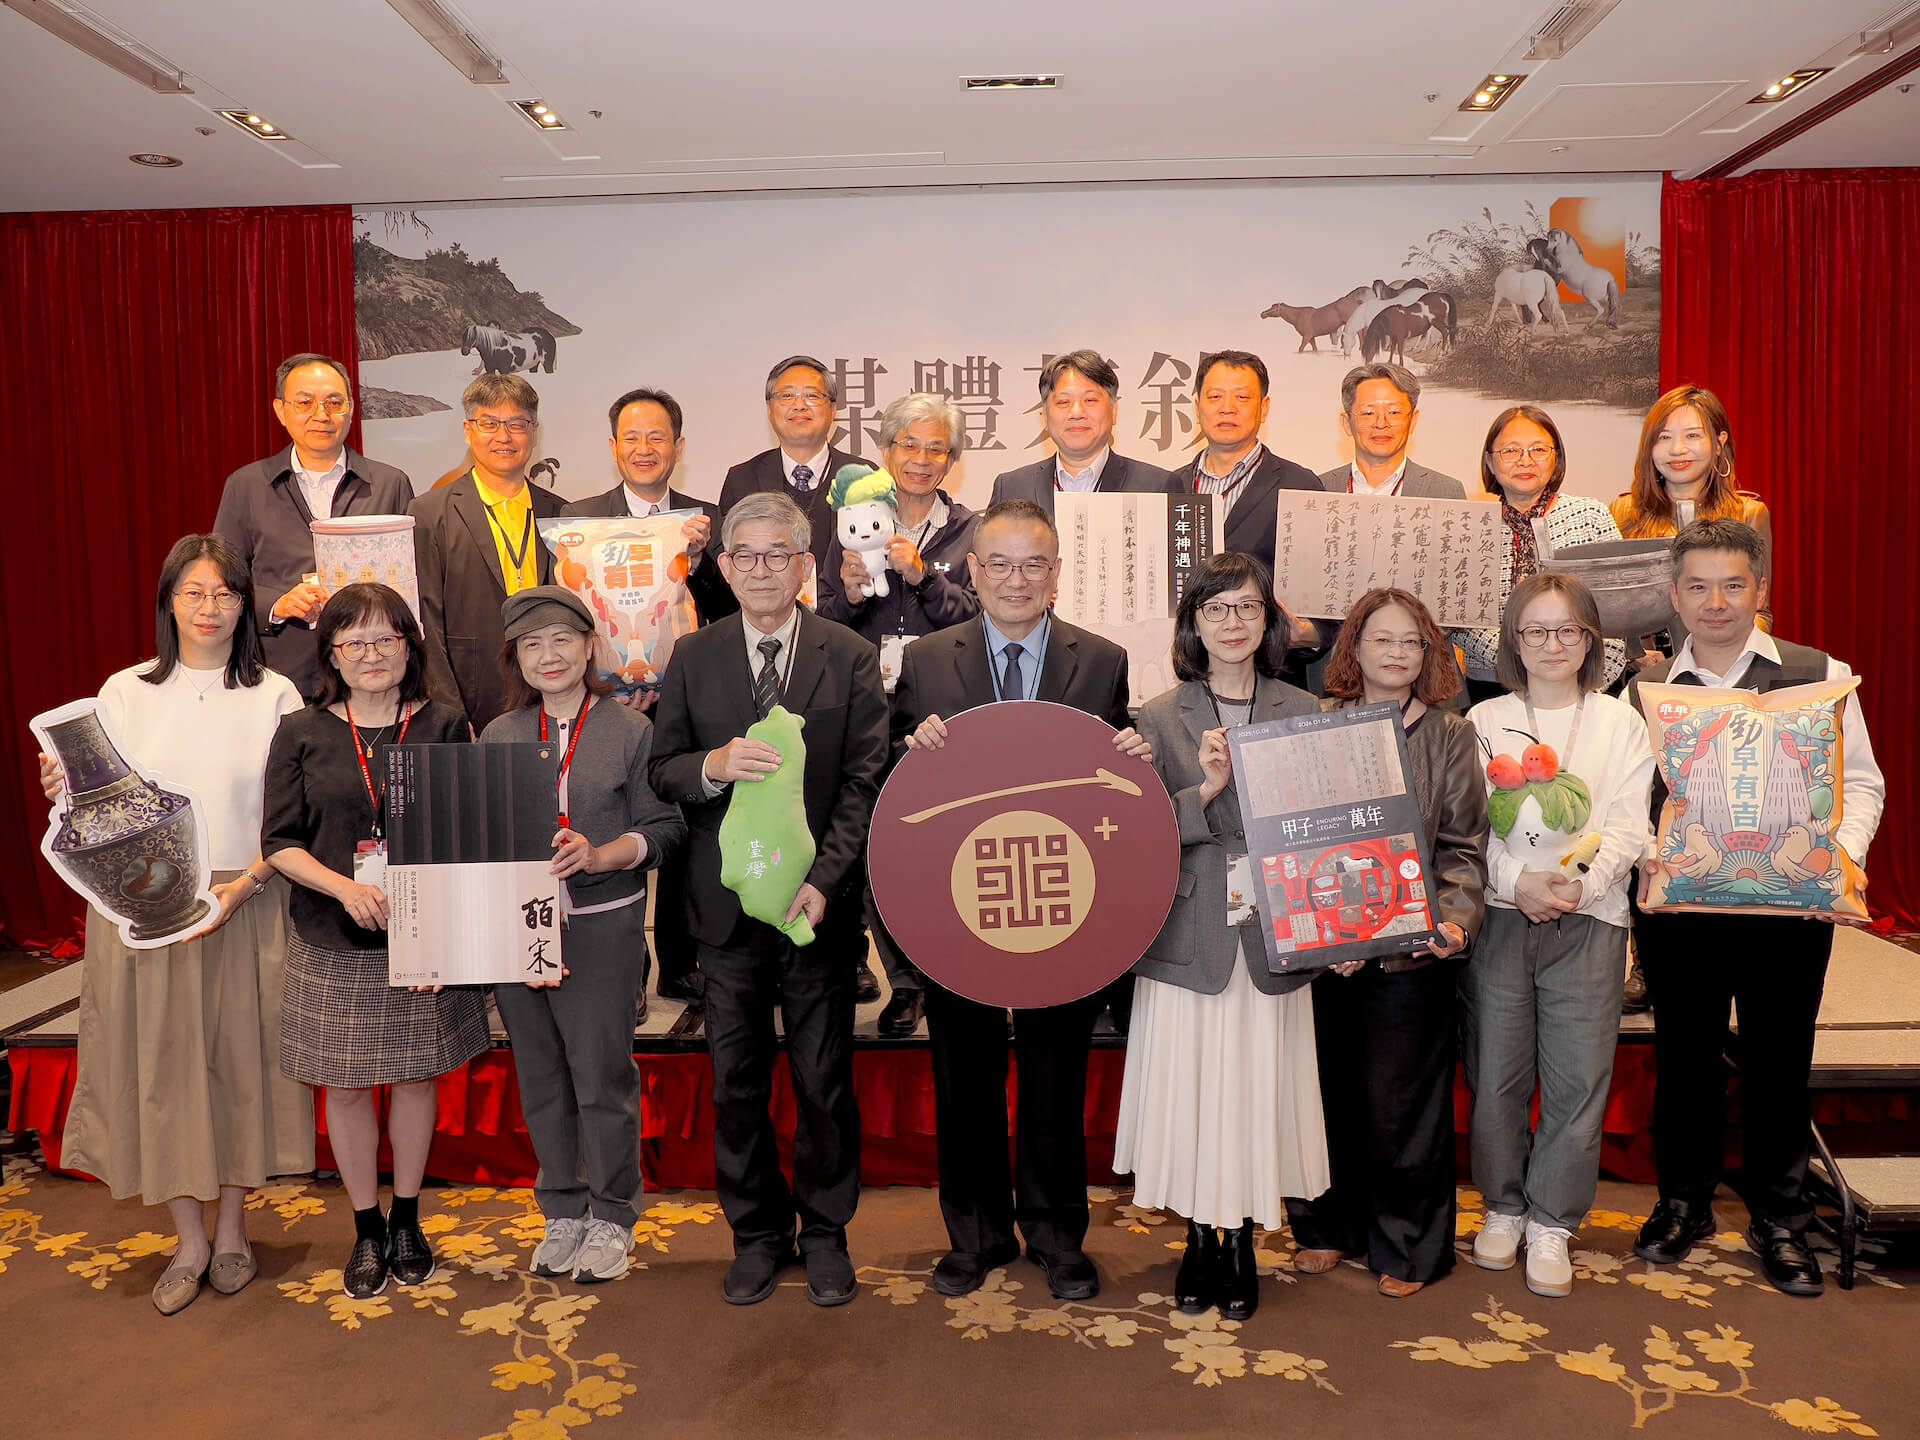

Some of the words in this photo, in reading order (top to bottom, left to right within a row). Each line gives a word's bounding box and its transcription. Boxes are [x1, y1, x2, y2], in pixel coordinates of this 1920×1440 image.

[1174, 503, 1192, 569] 千年神遇
[1729, 711, 1763, 828] 勁早有吉
[1281, 815, 1314, 840] 甲子
[1348, 804, 1385, 830] 萬年
[1316, 814, 1348, 826] ENDURING
[1317, 822, 1341, 832] LEGACY
